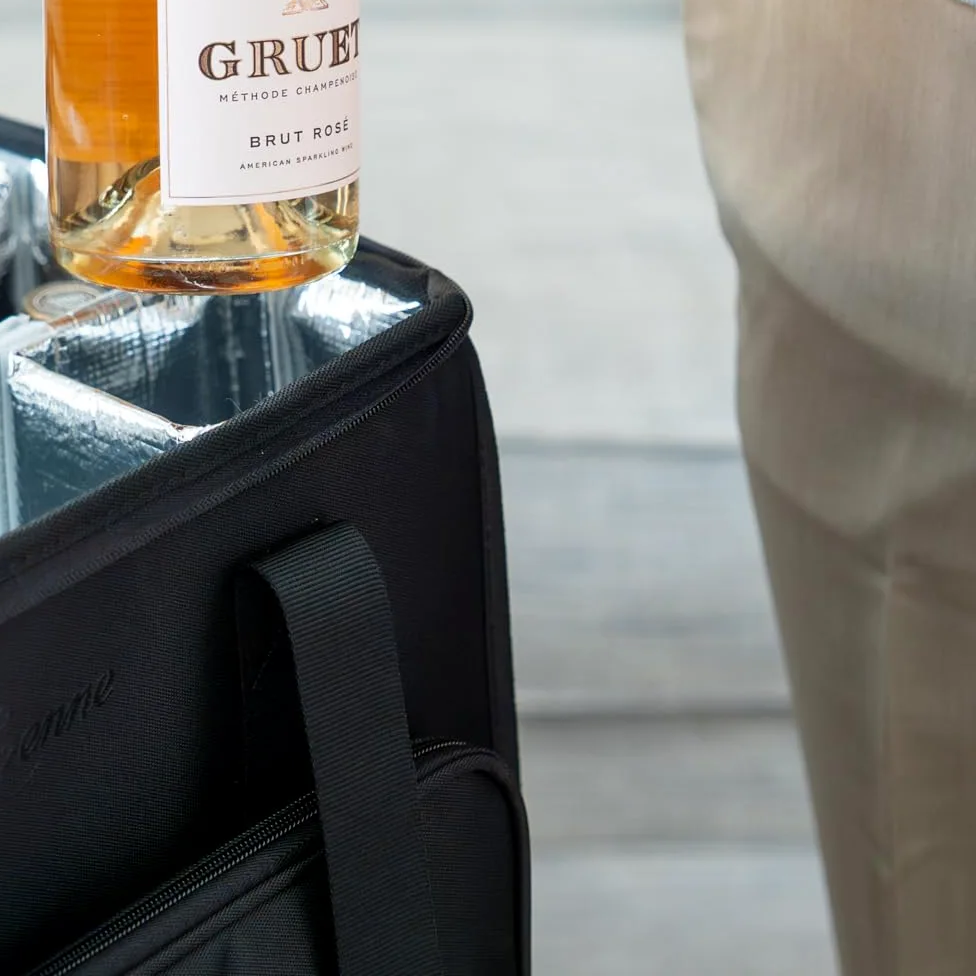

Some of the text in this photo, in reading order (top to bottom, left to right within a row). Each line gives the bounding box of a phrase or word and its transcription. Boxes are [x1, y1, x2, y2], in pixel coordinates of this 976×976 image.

[198, 17, 359, 81] GRUET
[219, 88, 288, 103] MÉTHODE
[250, 117, 350, 148] BRUT ROSÉ
[239, 158, 291, 170] AMERICAN
[296, 148, 339, 164] SPARKLING
